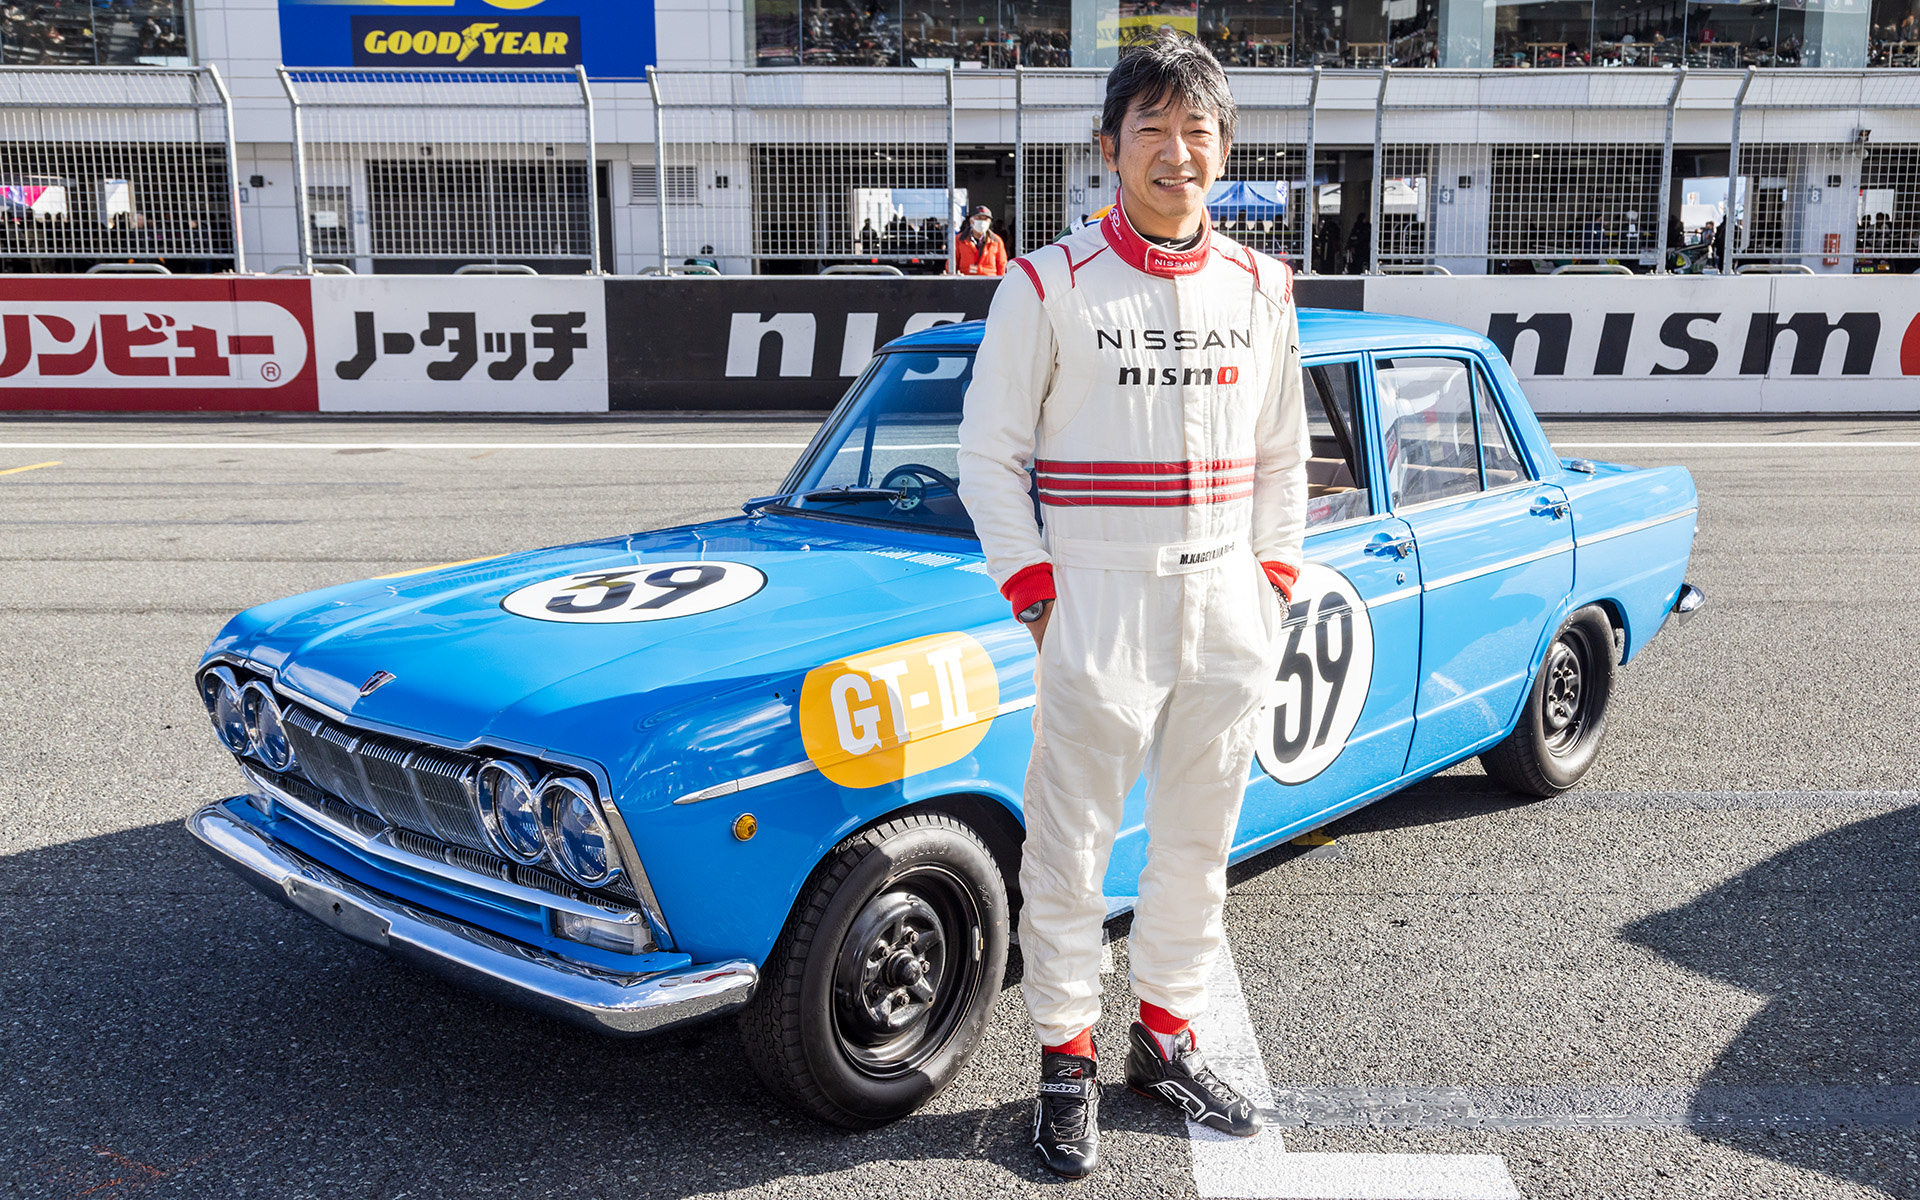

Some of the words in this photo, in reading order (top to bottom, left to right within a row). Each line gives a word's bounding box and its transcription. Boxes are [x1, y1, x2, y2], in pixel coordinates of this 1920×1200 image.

[1442, 191, 1451, 203] 9
[1811, 190, 1820, 202] 8
[1154, 258, 1198, 269] NISSAN
[336, 311, 588, 381] ノータッチ
[1097, 329, 1250, 351] NISSAN
[1118, 366, 1239, 387] nismo
[545, 564, 728, 614] 39
[1270, 591, 1354, 764] 39
